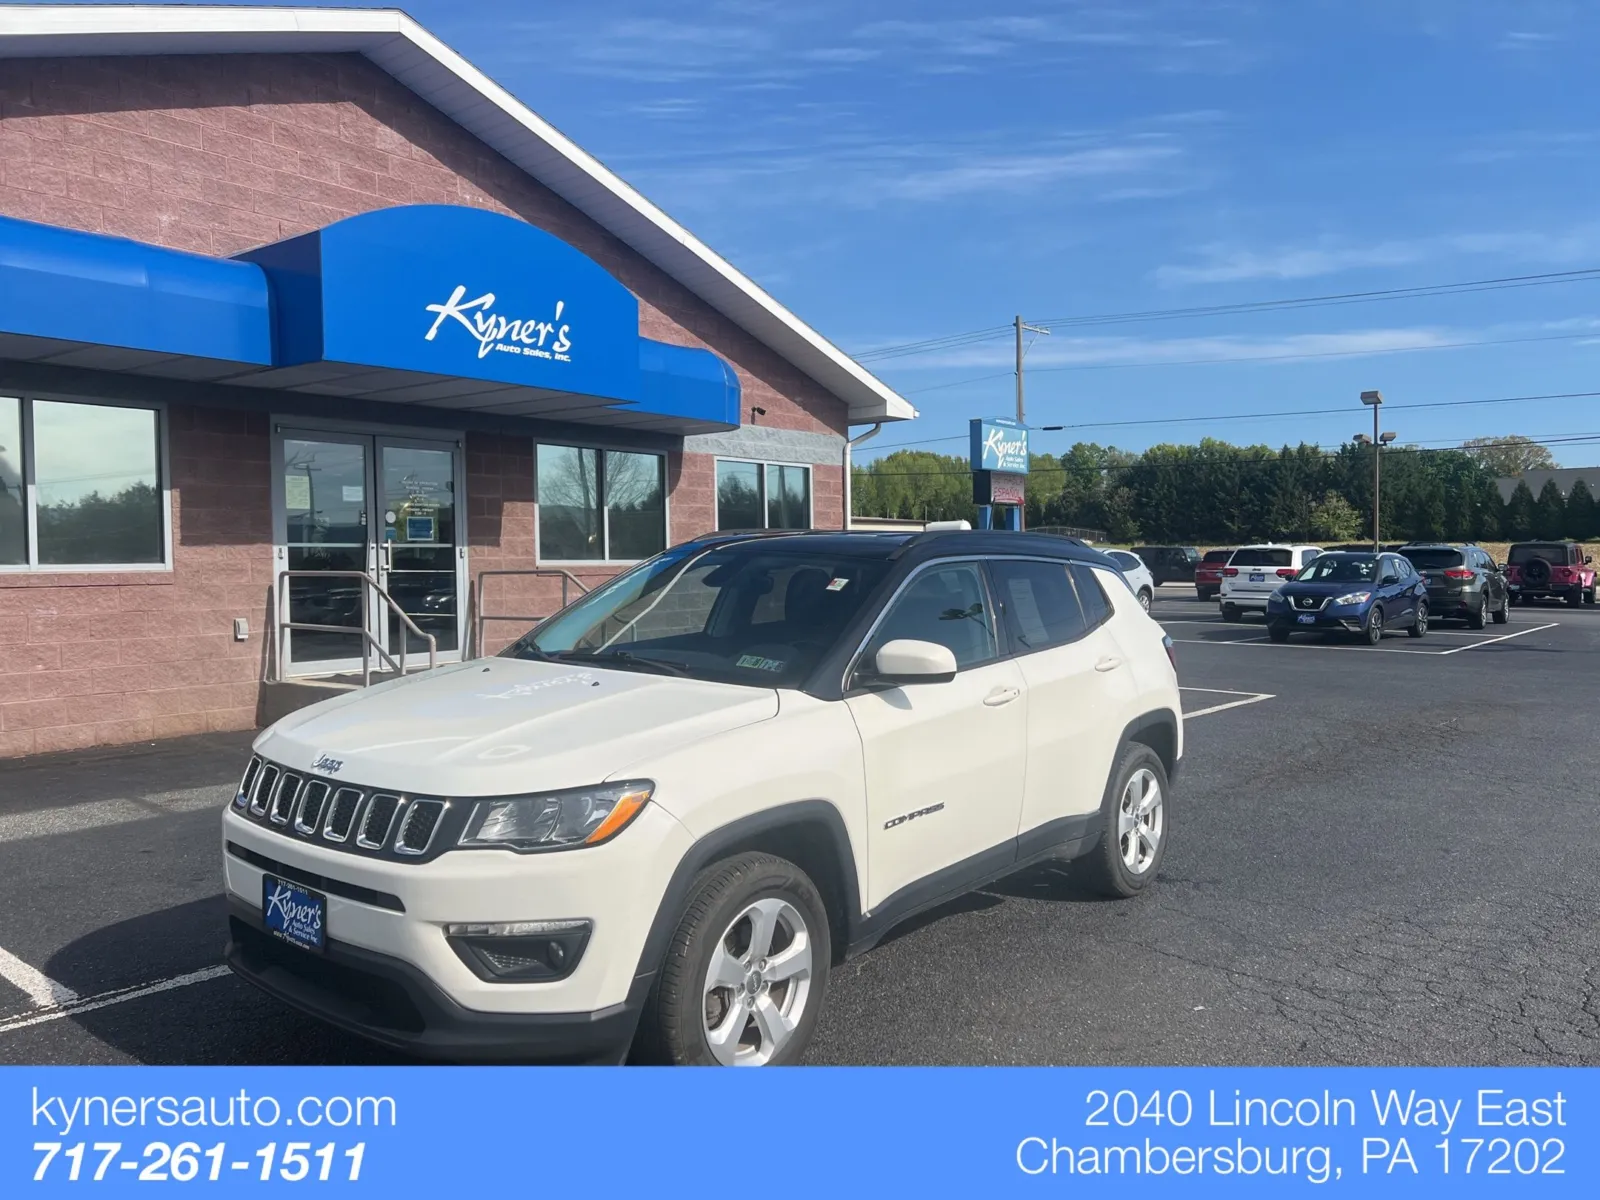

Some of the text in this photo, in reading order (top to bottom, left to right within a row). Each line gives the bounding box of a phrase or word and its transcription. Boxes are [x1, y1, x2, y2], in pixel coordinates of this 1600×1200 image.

[425, 285, 572, 359] Kyner's
[495, 343, 572, 362] Auto Sales, Inc.
[982, 428, 1027, 468] Kyner's
[311, 754, 343, 775] Jeep
[883, 802, 945, 830] COMPASS
[267, 885, 321, 930] Kyner's
